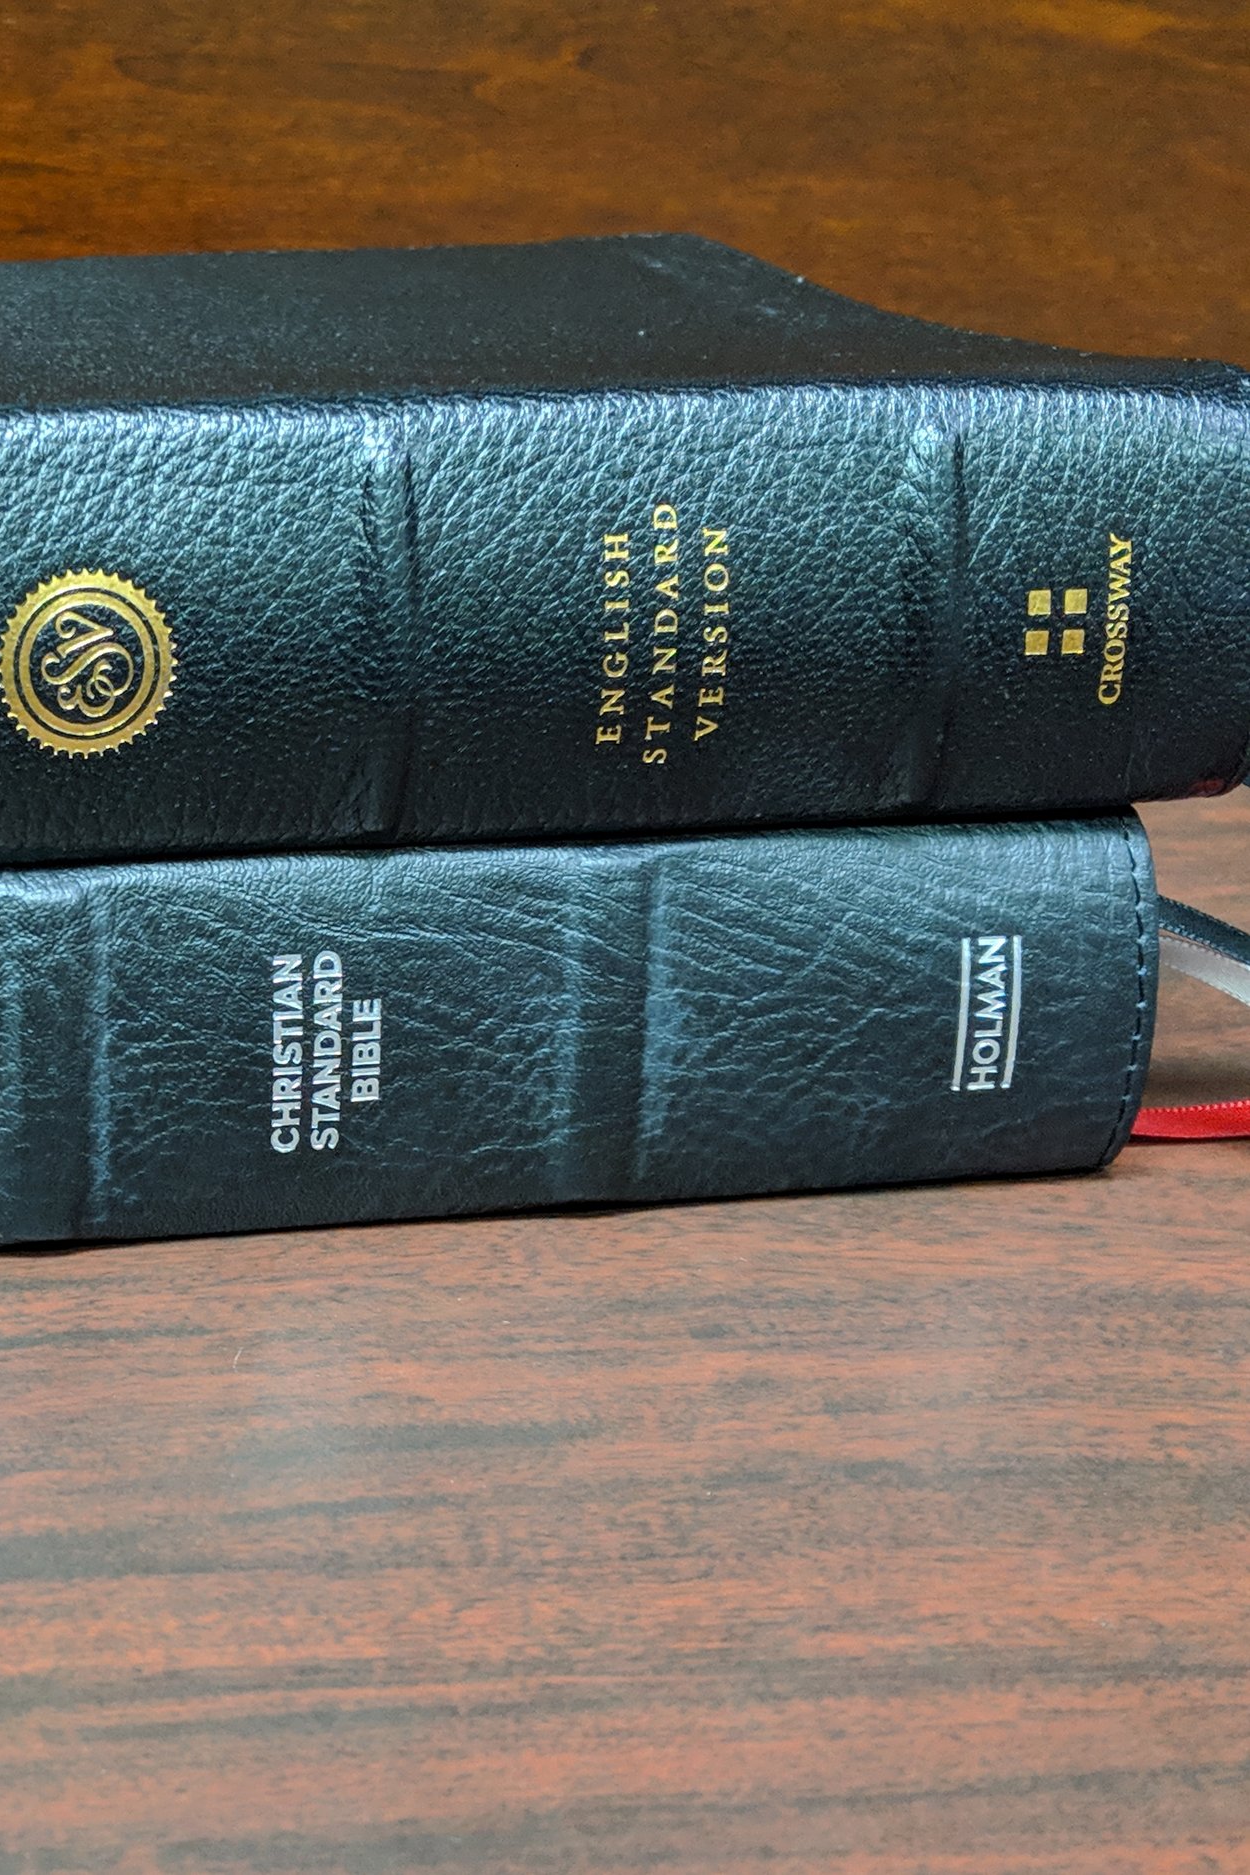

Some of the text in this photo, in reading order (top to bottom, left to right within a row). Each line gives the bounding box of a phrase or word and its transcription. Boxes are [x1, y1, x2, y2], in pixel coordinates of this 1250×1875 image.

[595, 533, 630, 745] ENGLISH
[643, 504, 679, 765] STANDARD
[694, 527, 730, 742] VERSION
[1098, 532, 1132, 705] CROSSWAY
[270, 953, 303, 1153] CHRISTIAN
[310, 950, 342, 1151] STANDARD
[350, 998, 381, 1103] BIBLE
[966, 935, 1007, 1091] HOLMAN
